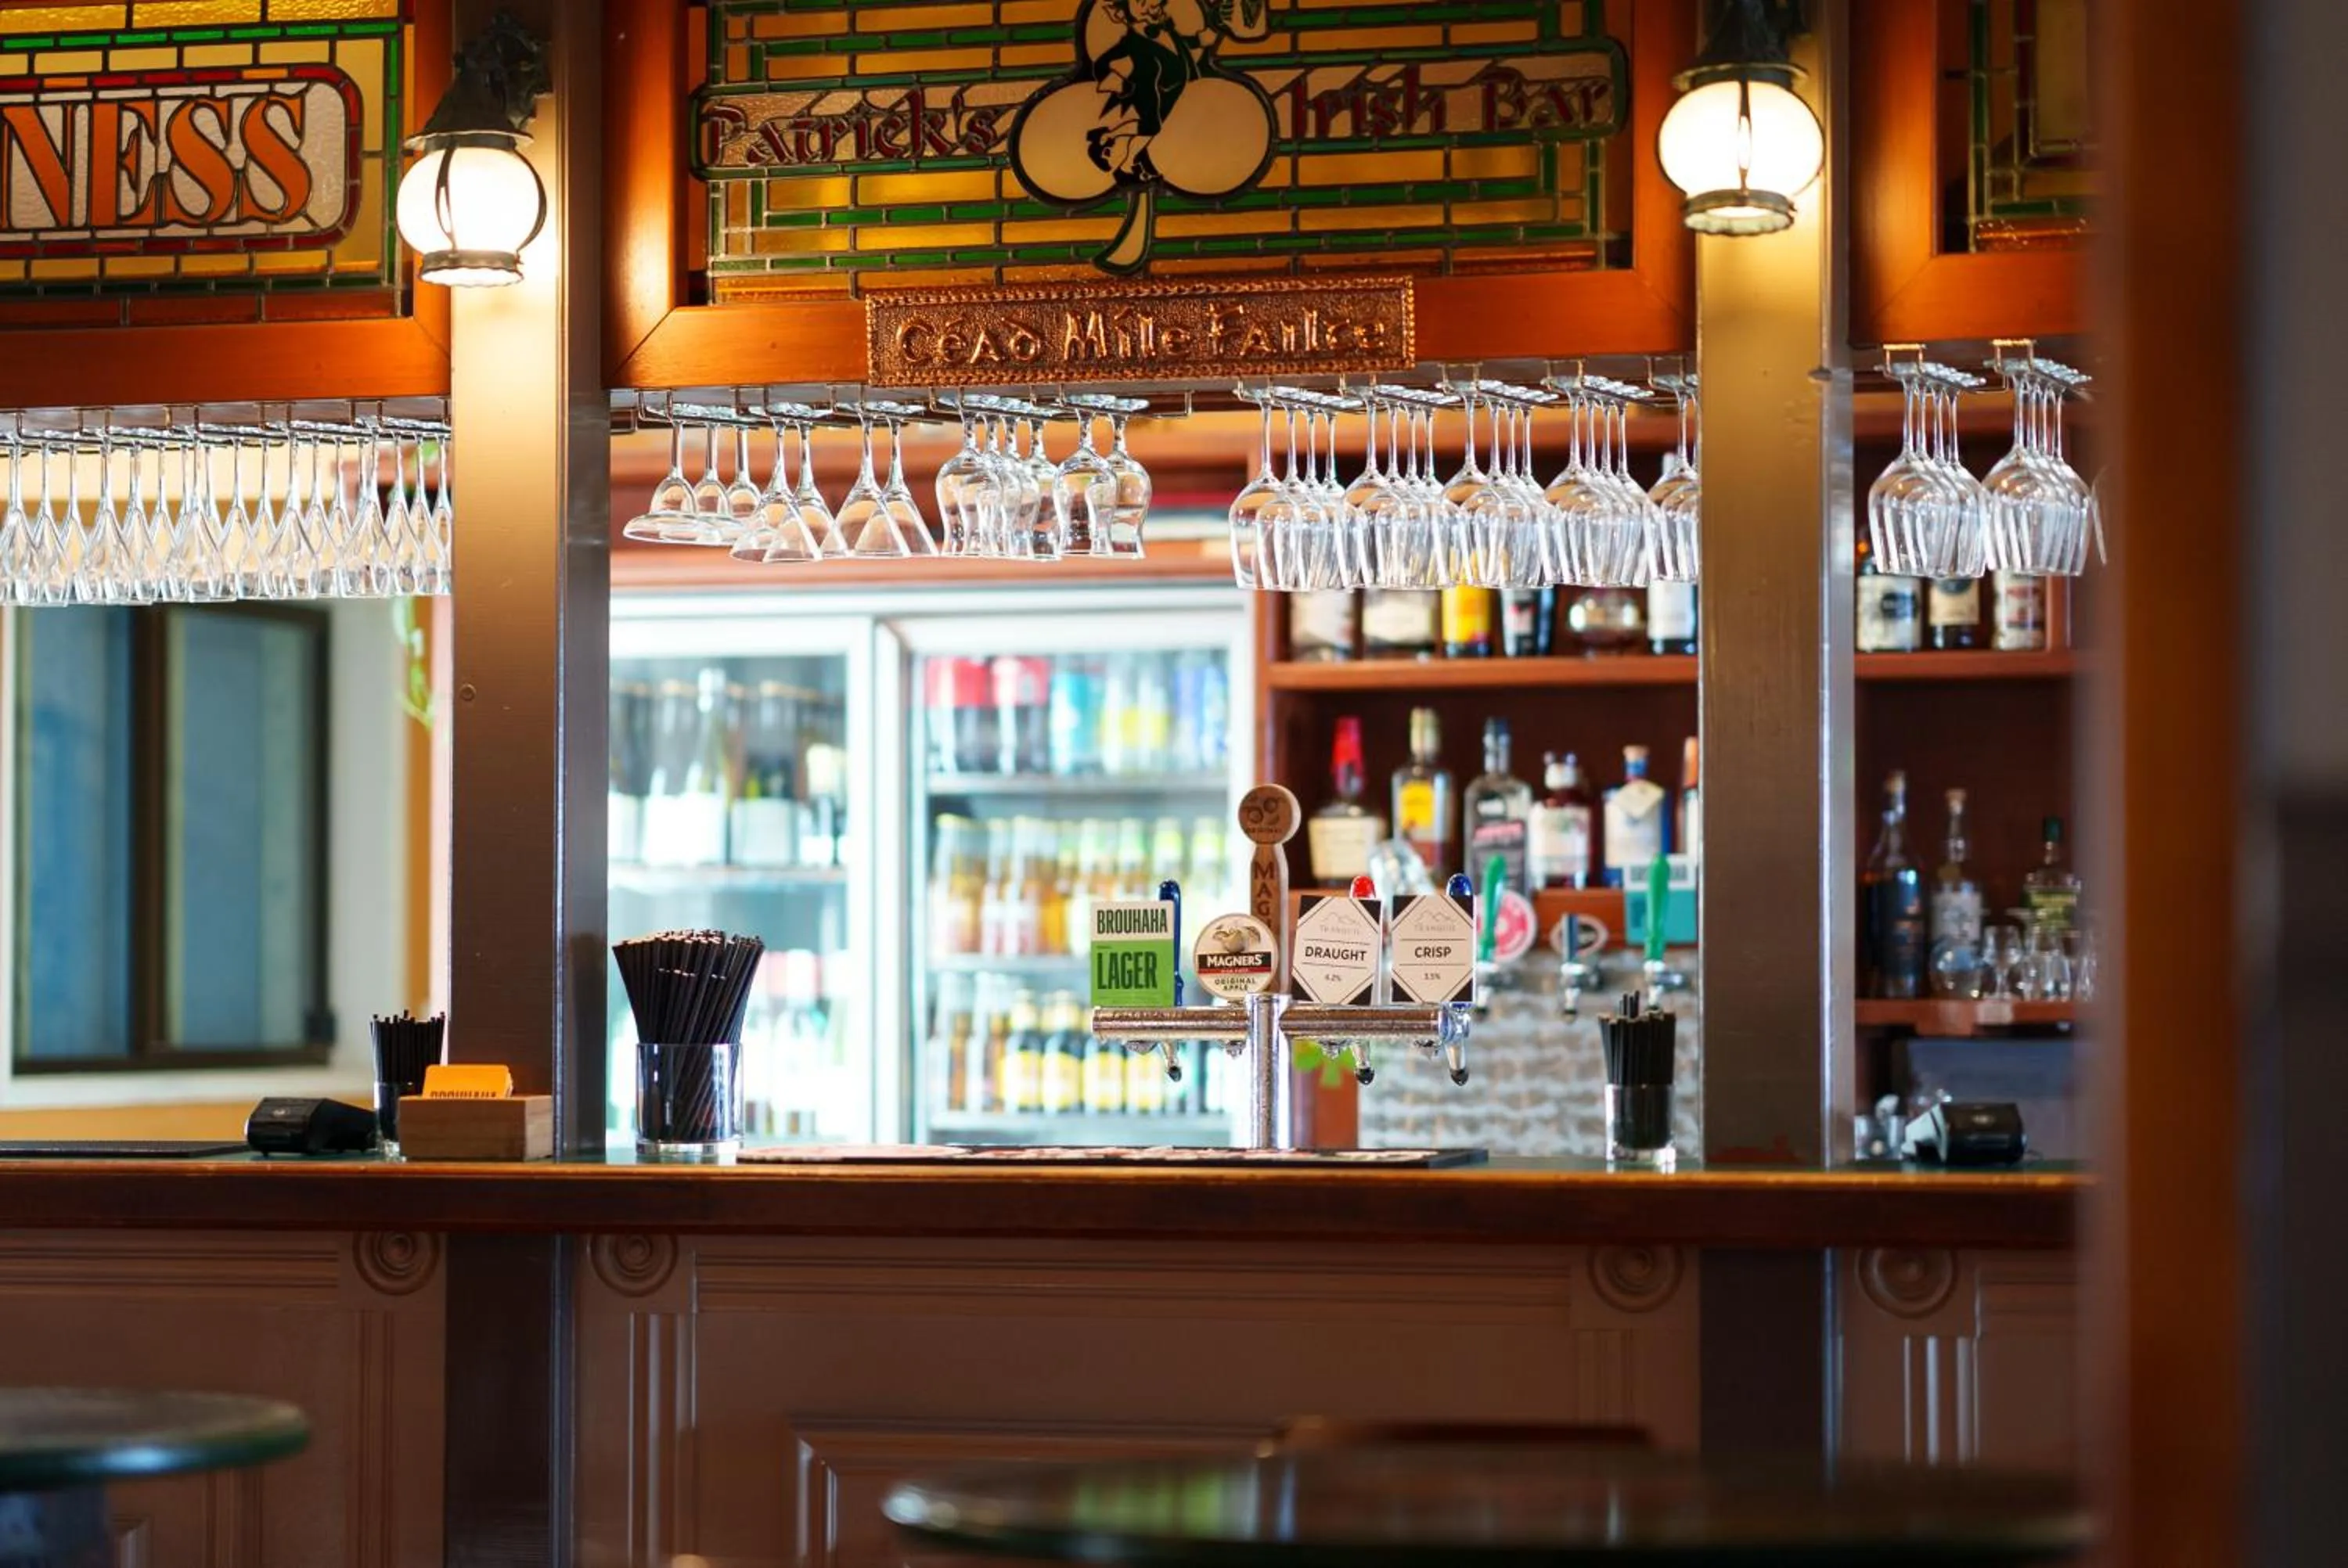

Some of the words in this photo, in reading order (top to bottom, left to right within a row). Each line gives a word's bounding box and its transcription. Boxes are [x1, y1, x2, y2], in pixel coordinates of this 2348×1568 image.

[1482, 66, 1609, 131] Bar
[1097, 908, 1169, 934] BROUHAHA
[1305, 946, 1367, 962] DRAUGHT
[1414, 946, 1452, 958] CRISP
[1207, 954, 1262, 968] MAGNERS
[1097, 951, 1158, 990] LAGER
[1214, 976, 1256, 986] ORIGINAL
